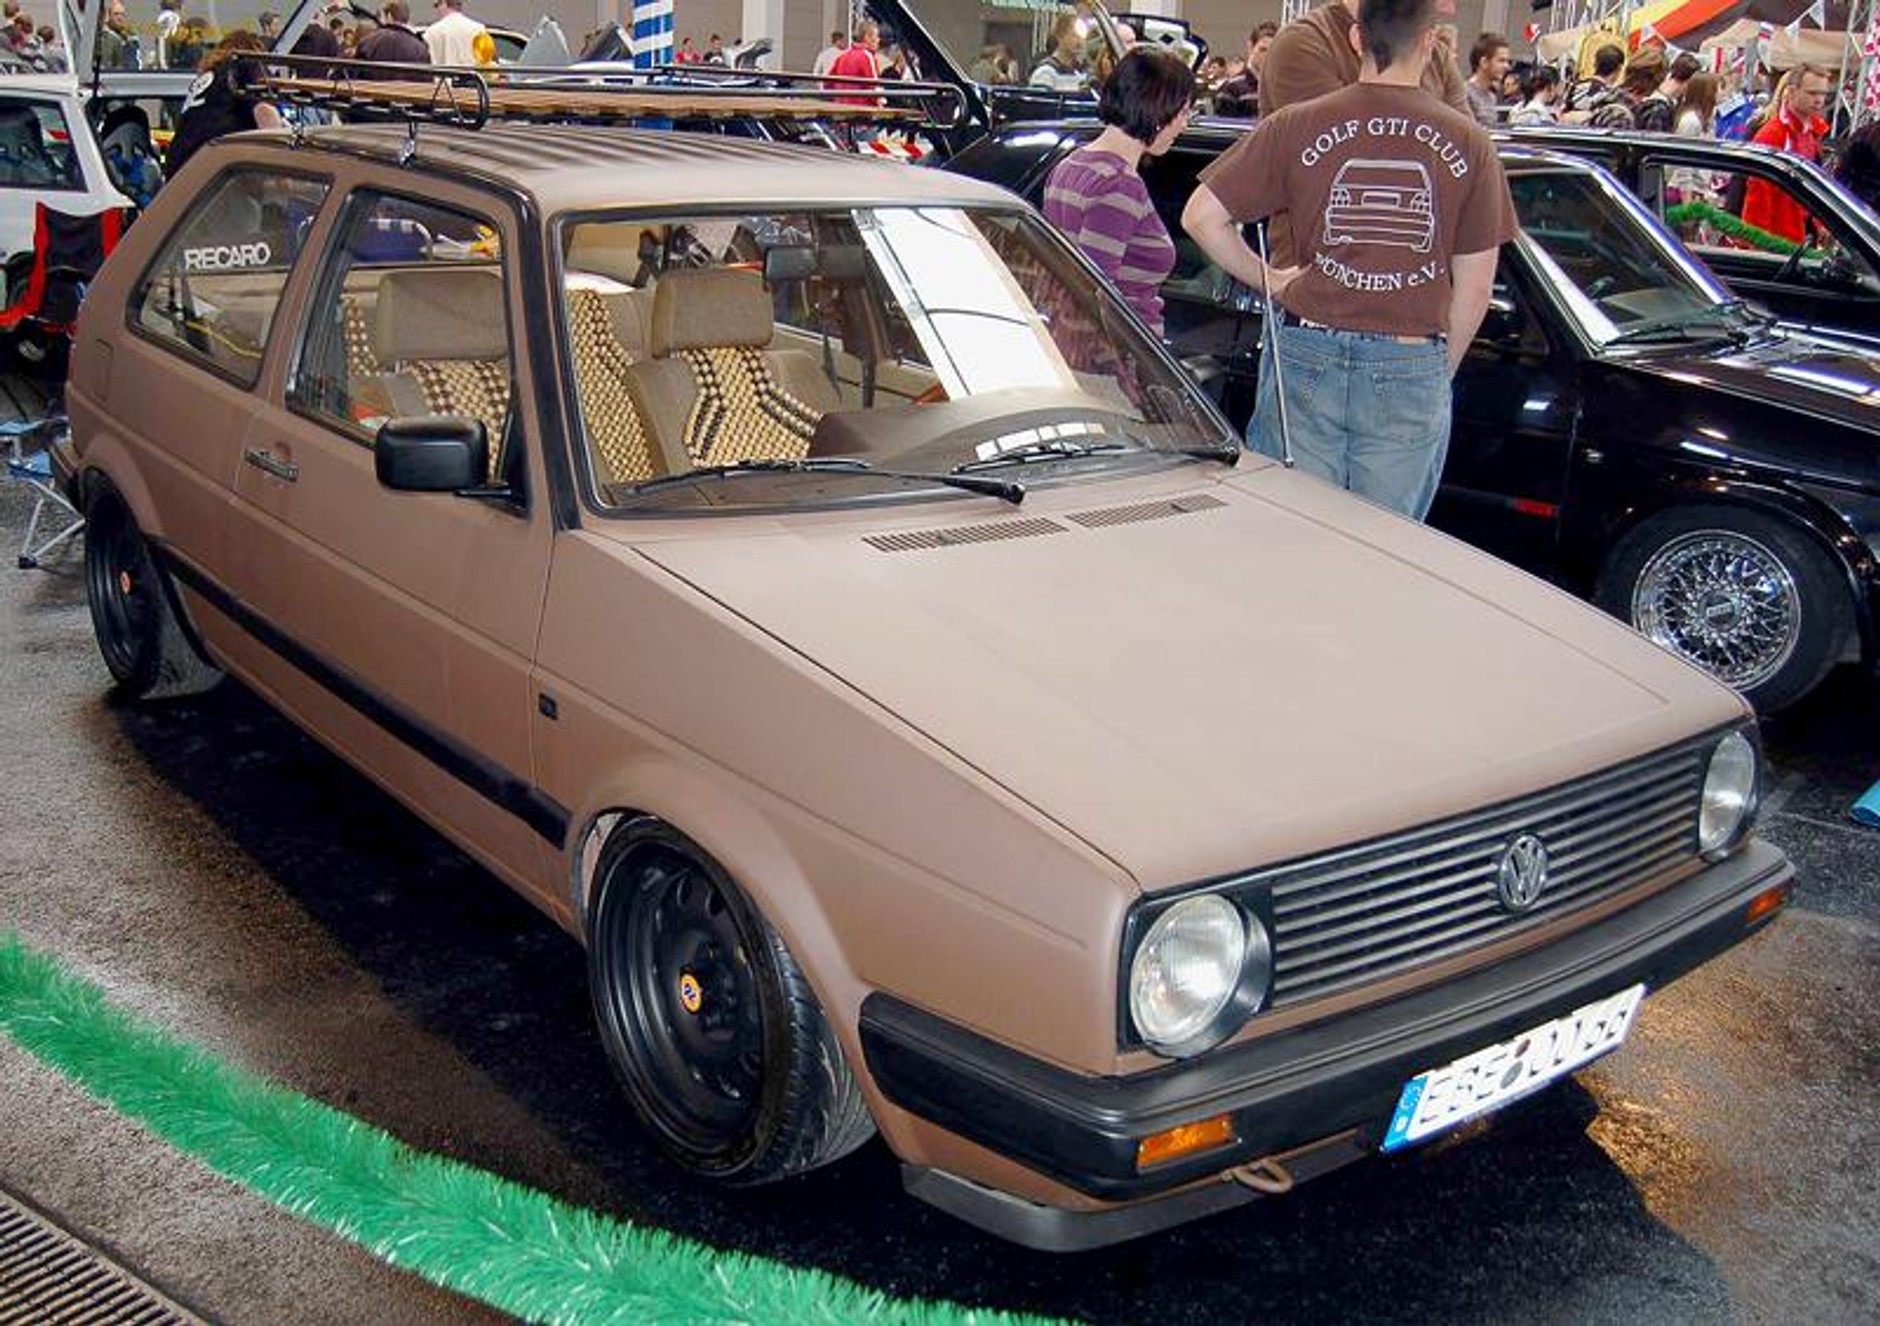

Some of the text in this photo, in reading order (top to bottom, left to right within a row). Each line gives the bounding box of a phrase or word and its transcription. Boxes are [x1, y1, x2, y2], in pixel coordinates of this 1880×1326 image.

[1301, 117, 1468, 179] GOLF GTI CLUB
[183, 241, 272, 271] RECARO
